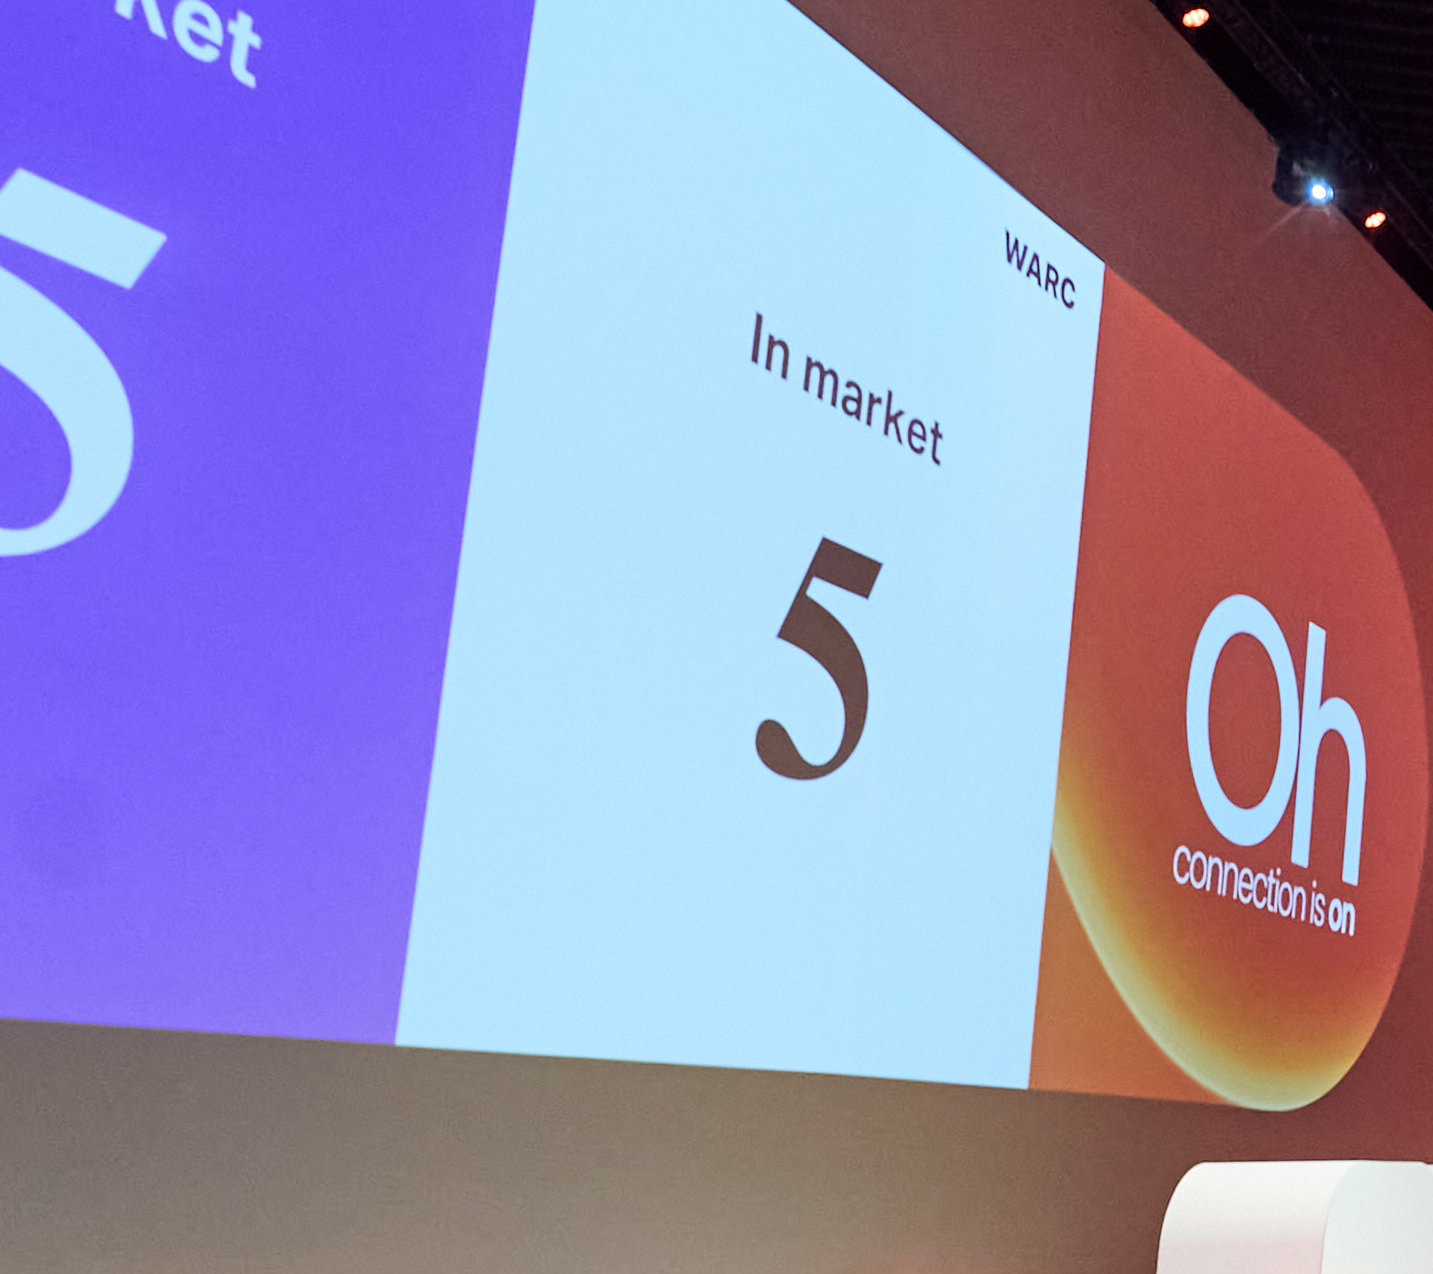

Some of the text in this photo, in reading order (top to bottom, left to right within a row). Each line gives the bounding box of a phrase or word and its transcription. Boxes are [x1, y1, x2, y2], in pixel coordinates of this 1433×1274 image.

[1004, 229, 1077, 311] WARC
[751, 312, 943, 466] In market
[755, 536, 883, 781] 5
[1186, 594, 1367, 887] Oh
[1172, 844, 1356, 937] connection is on
